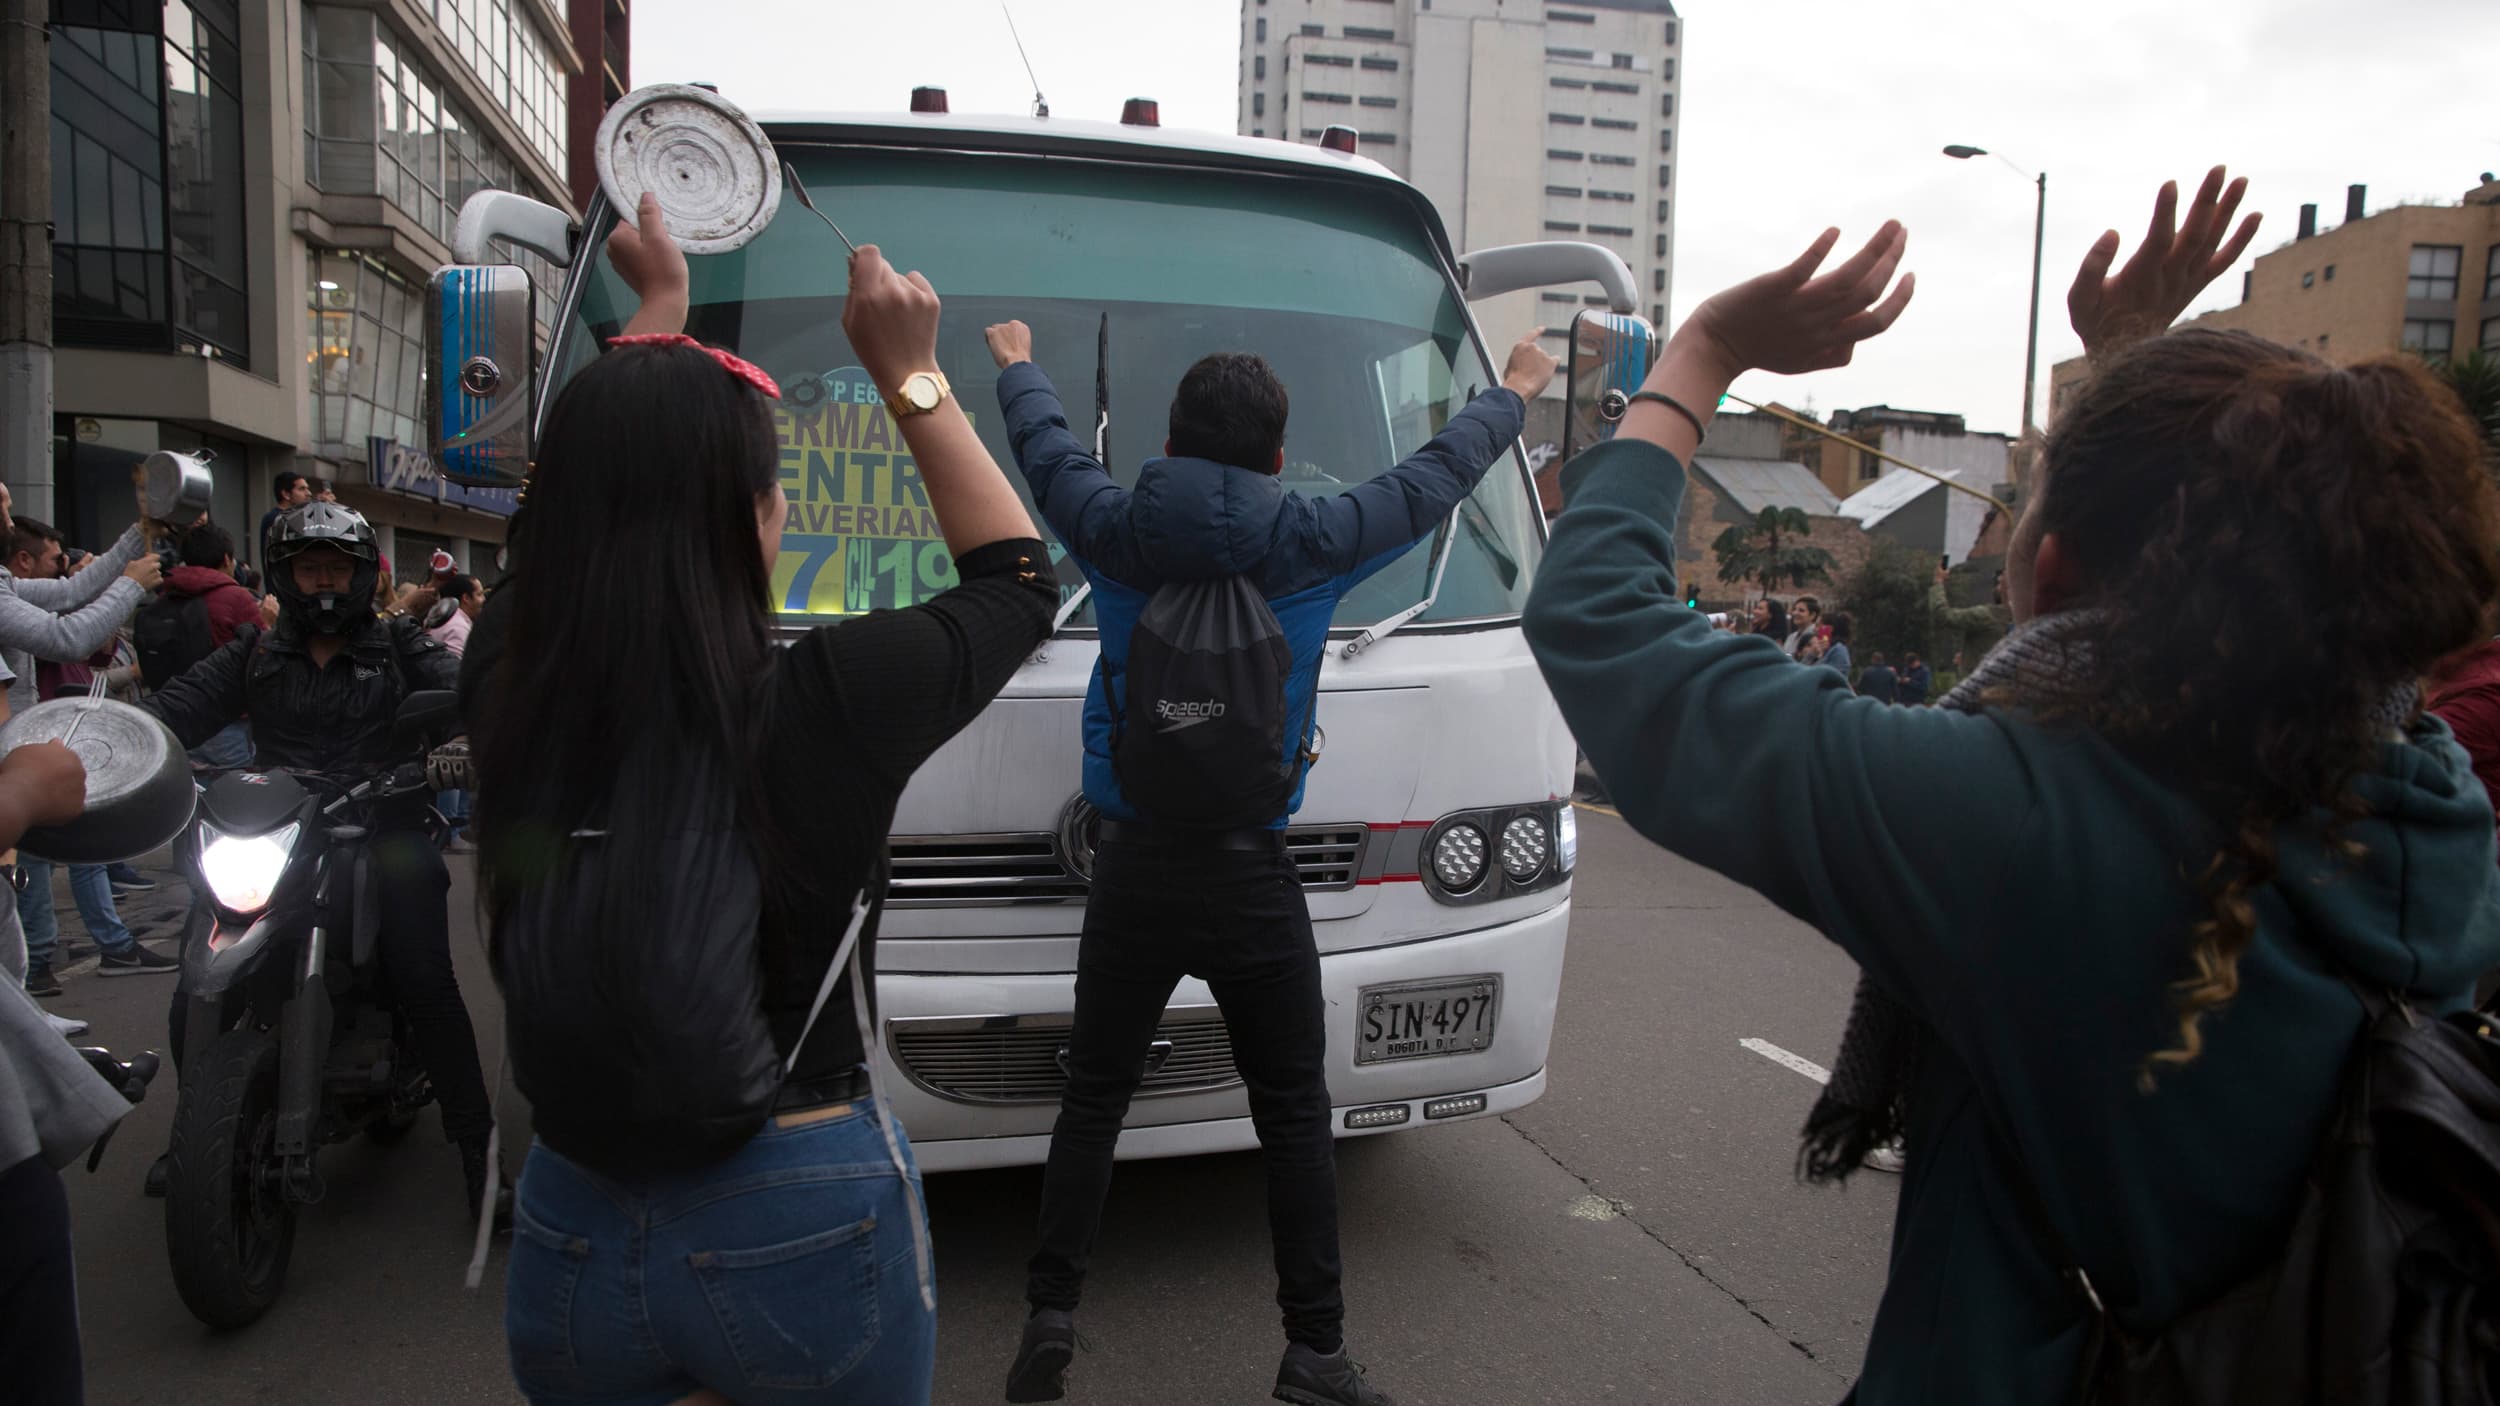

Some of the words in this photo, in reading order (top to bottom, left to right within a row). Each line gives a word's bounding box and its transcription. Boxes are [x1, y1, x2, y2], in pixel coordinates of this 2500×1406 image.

[853, 382, 885, 405] E6
[777, 449, 930, 507] ENTR
[1155, 698, 1226, 719] speedo
